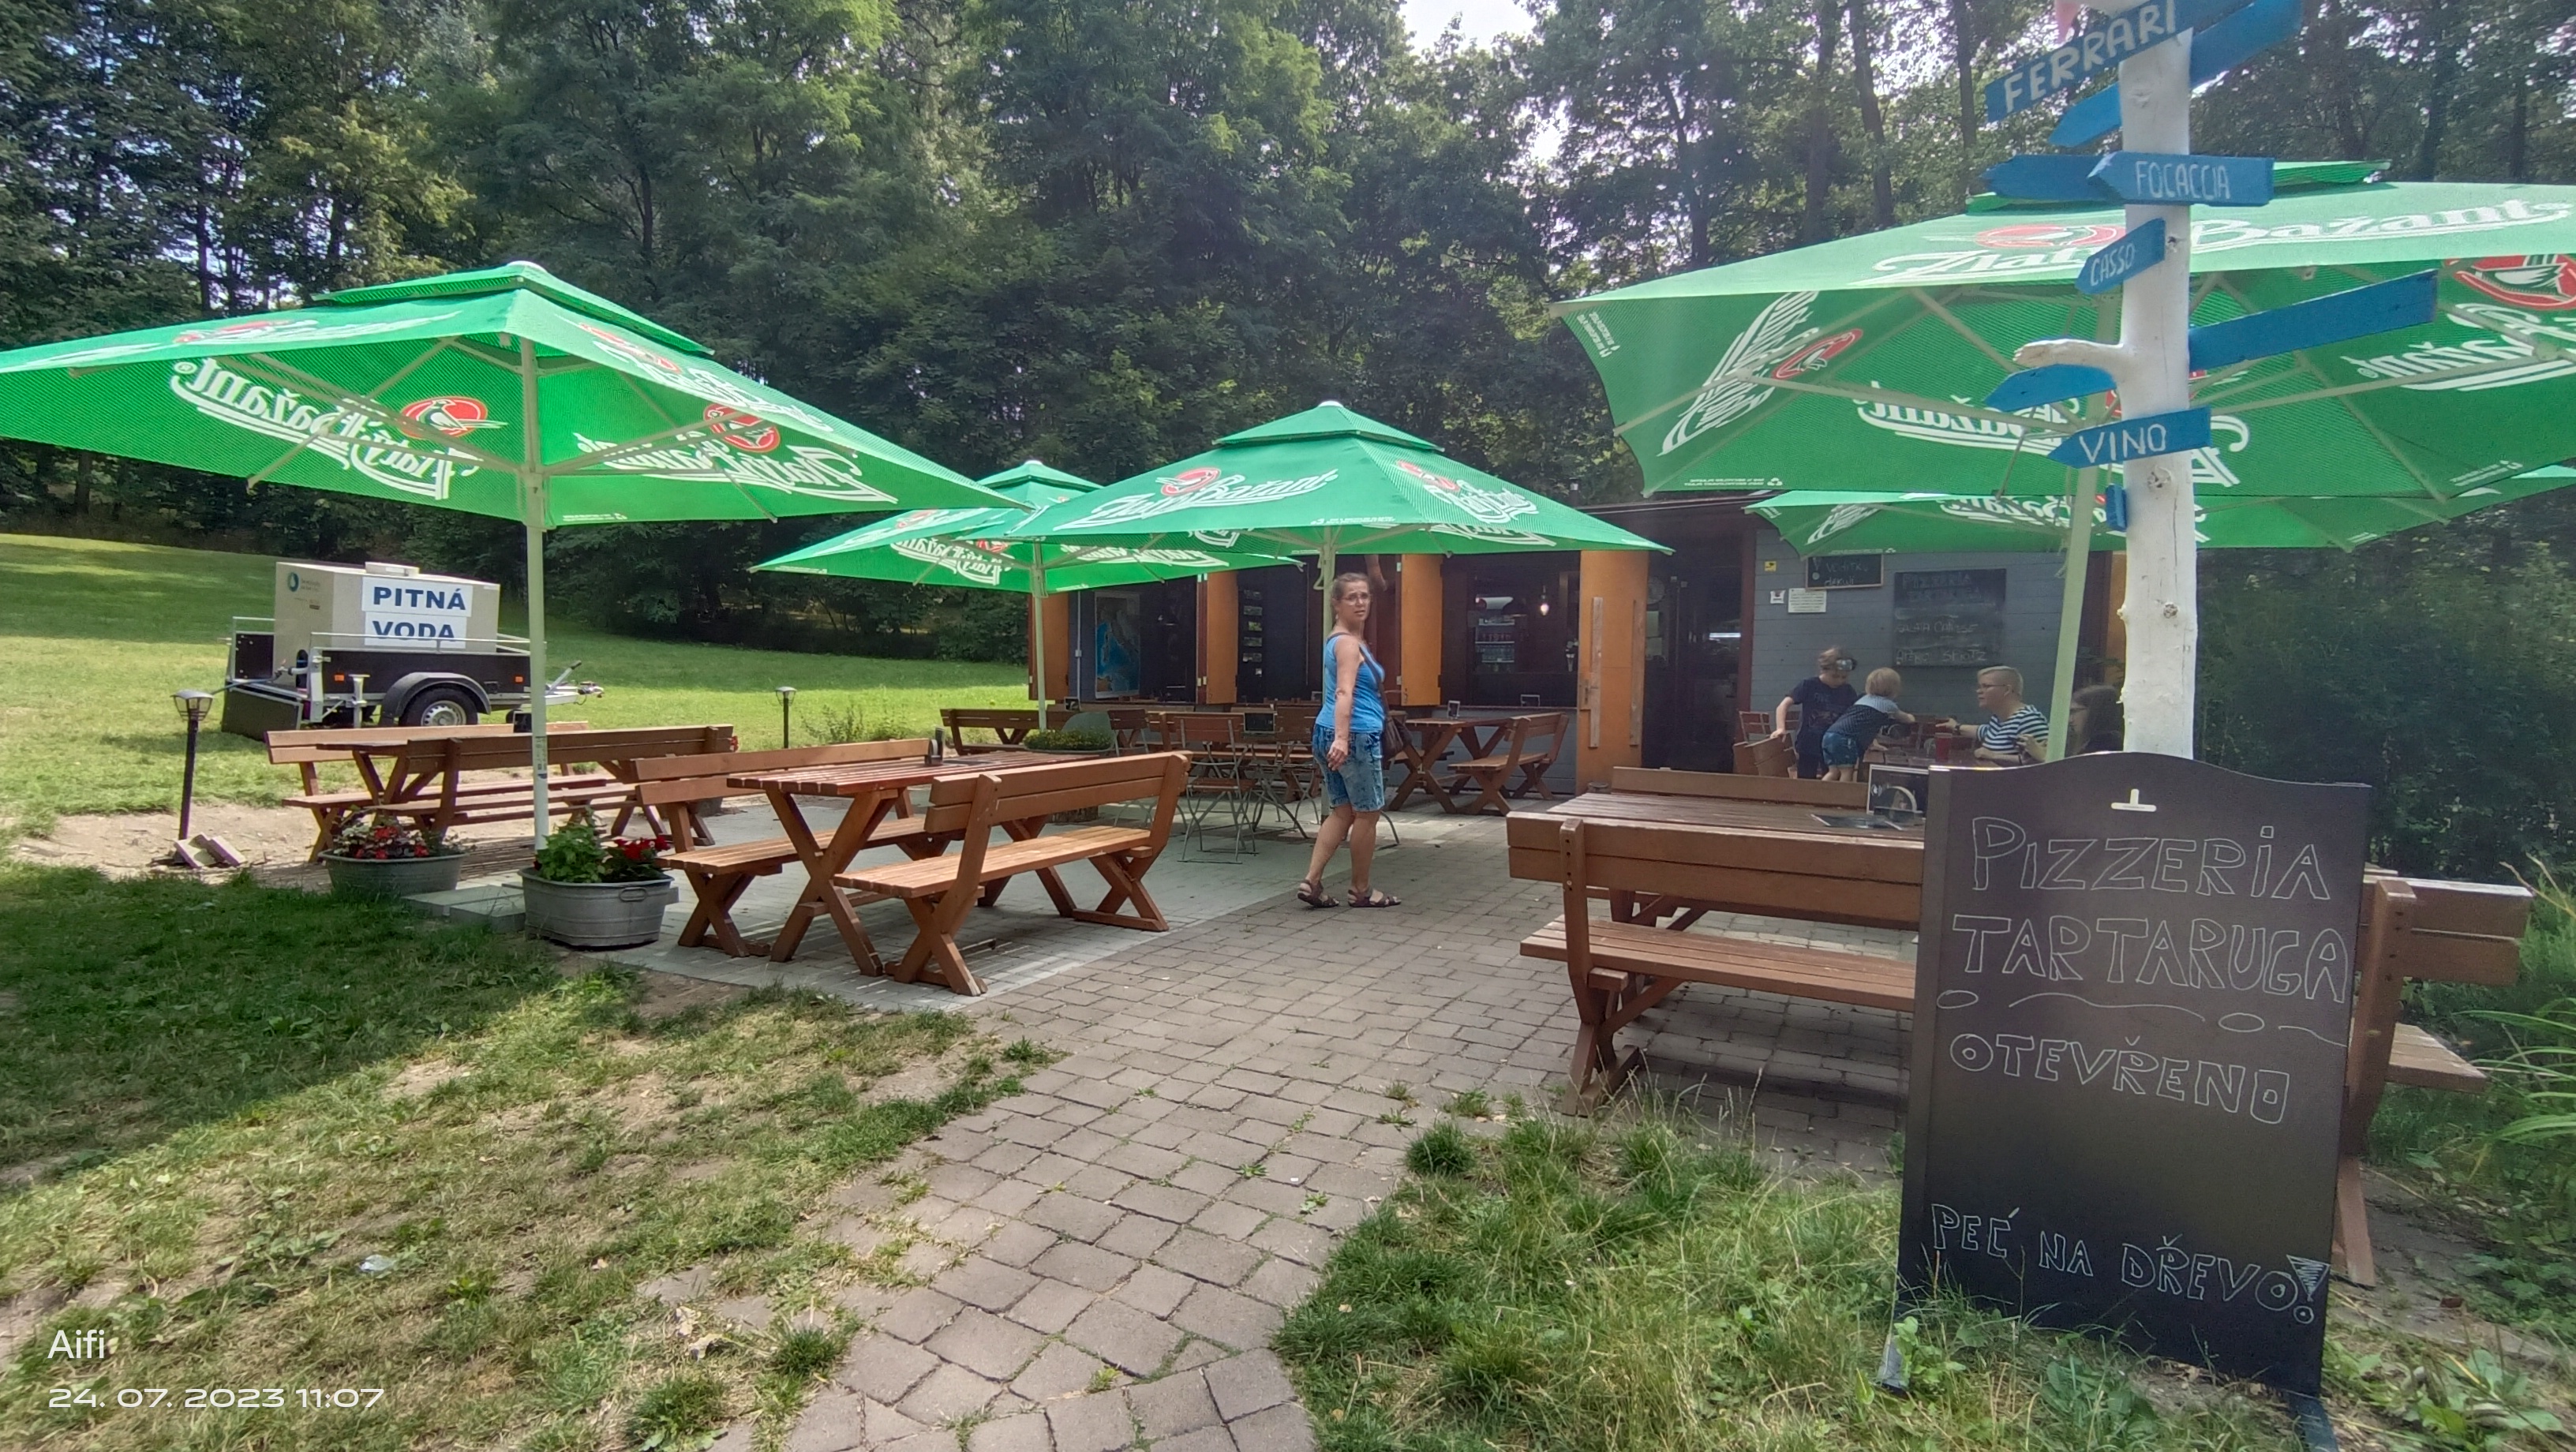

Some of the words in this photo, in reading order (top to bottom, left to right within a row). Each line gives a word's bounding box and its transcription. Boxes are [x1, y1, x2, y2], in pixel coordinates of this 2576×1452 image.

[2004, 0, 2177, 114] FERRARI
[2135, 160, 2231, 200] FOCACCIA
[1851, 247, 2085, 287] Zlat
[2090, 242, 2136, 294] CASSO
[2079, 423, 2167, 464] VINO
[373, 586, 466, 611] PITNÁ
[373, 620, 455, 642] VODA
[1953, 914, 2349, 1004] TARTARUGA
[1949, 1034, 2290, 1124] OTEVŘENO
[2039, 1230, 2094, 1277] NA
